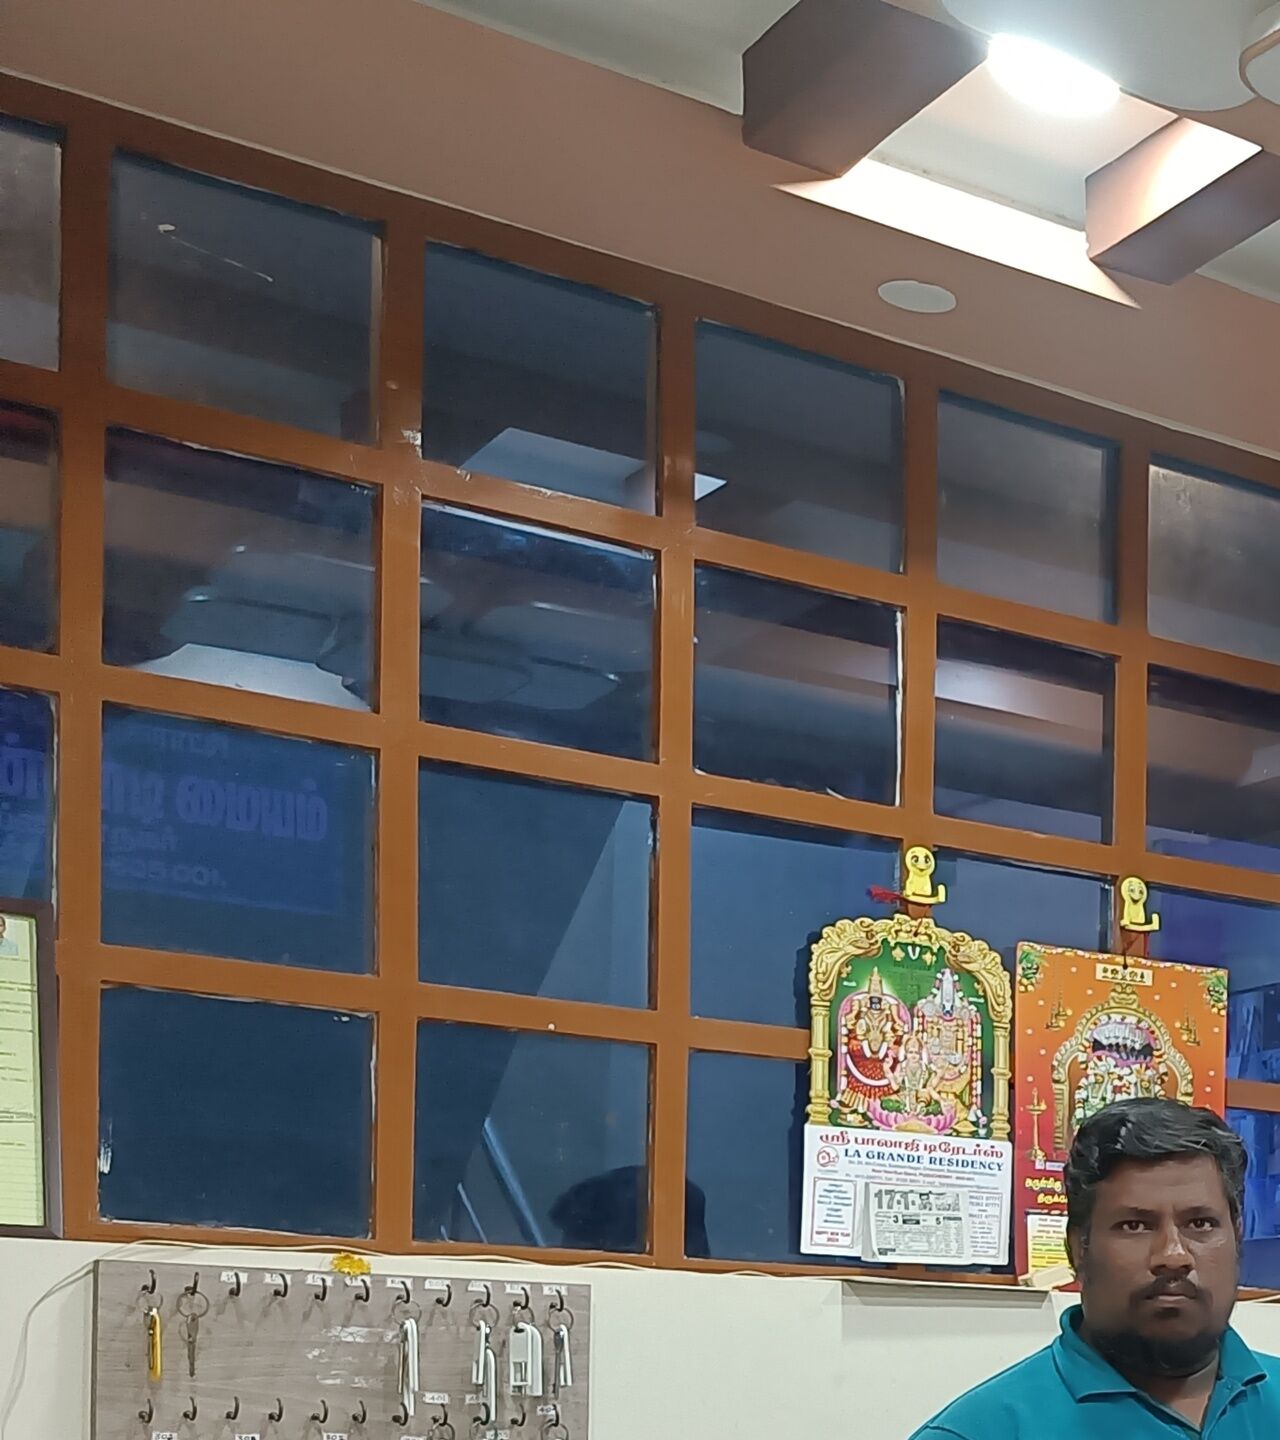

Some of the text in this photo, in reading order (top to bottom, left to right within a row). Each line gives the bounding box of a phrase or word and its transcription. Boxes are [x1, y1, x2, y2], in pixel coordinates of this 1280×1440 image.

[844, 1148, 864, 1159] LA
[866, 1149, 925, 1165] GRANDE
[928, 1153, 1005, 1172] RESIDENCY
